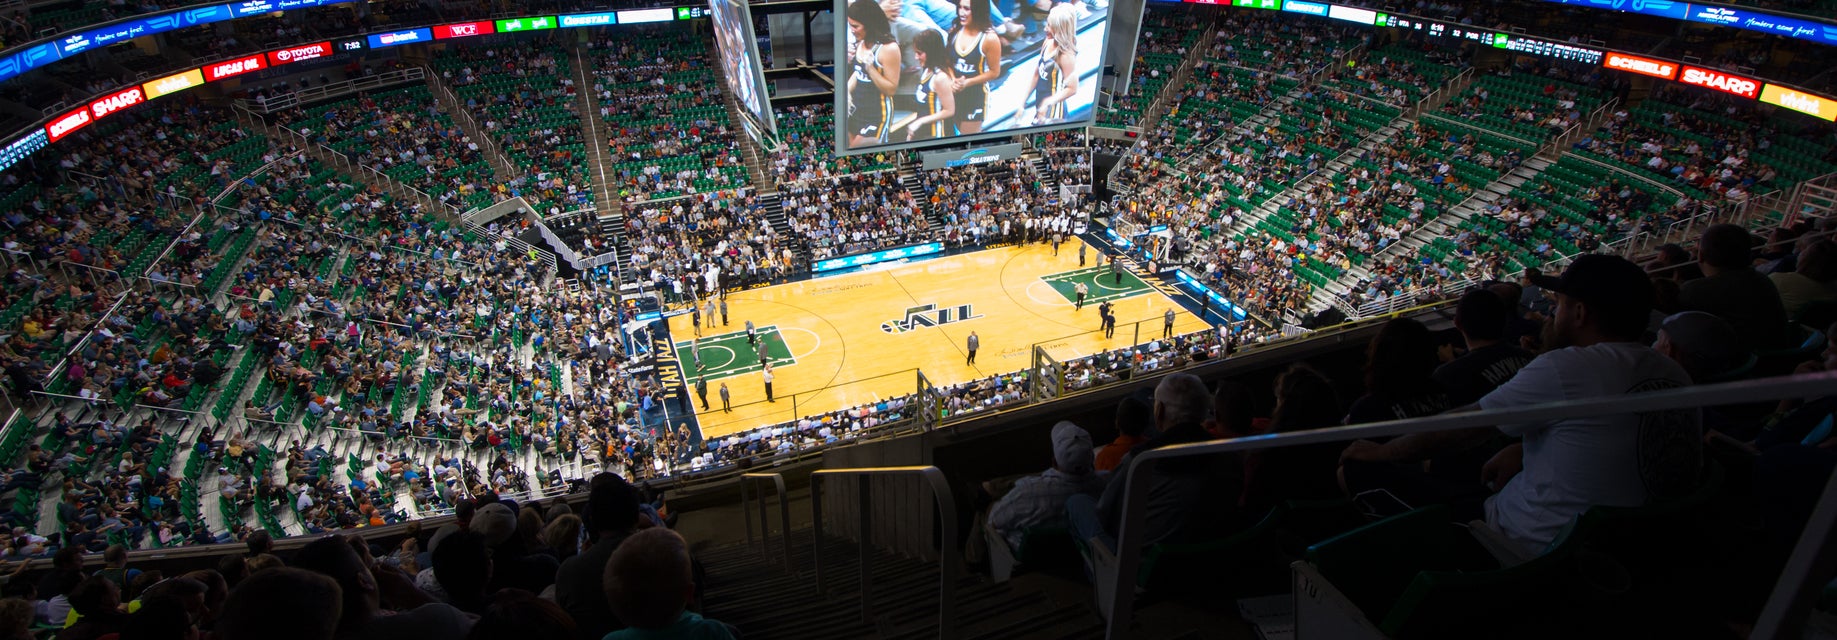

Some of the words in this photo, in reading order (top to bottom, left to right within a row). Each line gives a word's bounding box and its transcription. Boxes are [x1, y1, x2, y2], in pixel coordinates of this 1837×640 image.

[452, 25, 476, 36] WCF
[290, 45, 324, 57] TOYOTA
[344, 42, 361, 50] 7:52
[213, 62, 243, 78] LUCAS
[243, 58, 259, 71] OIL
